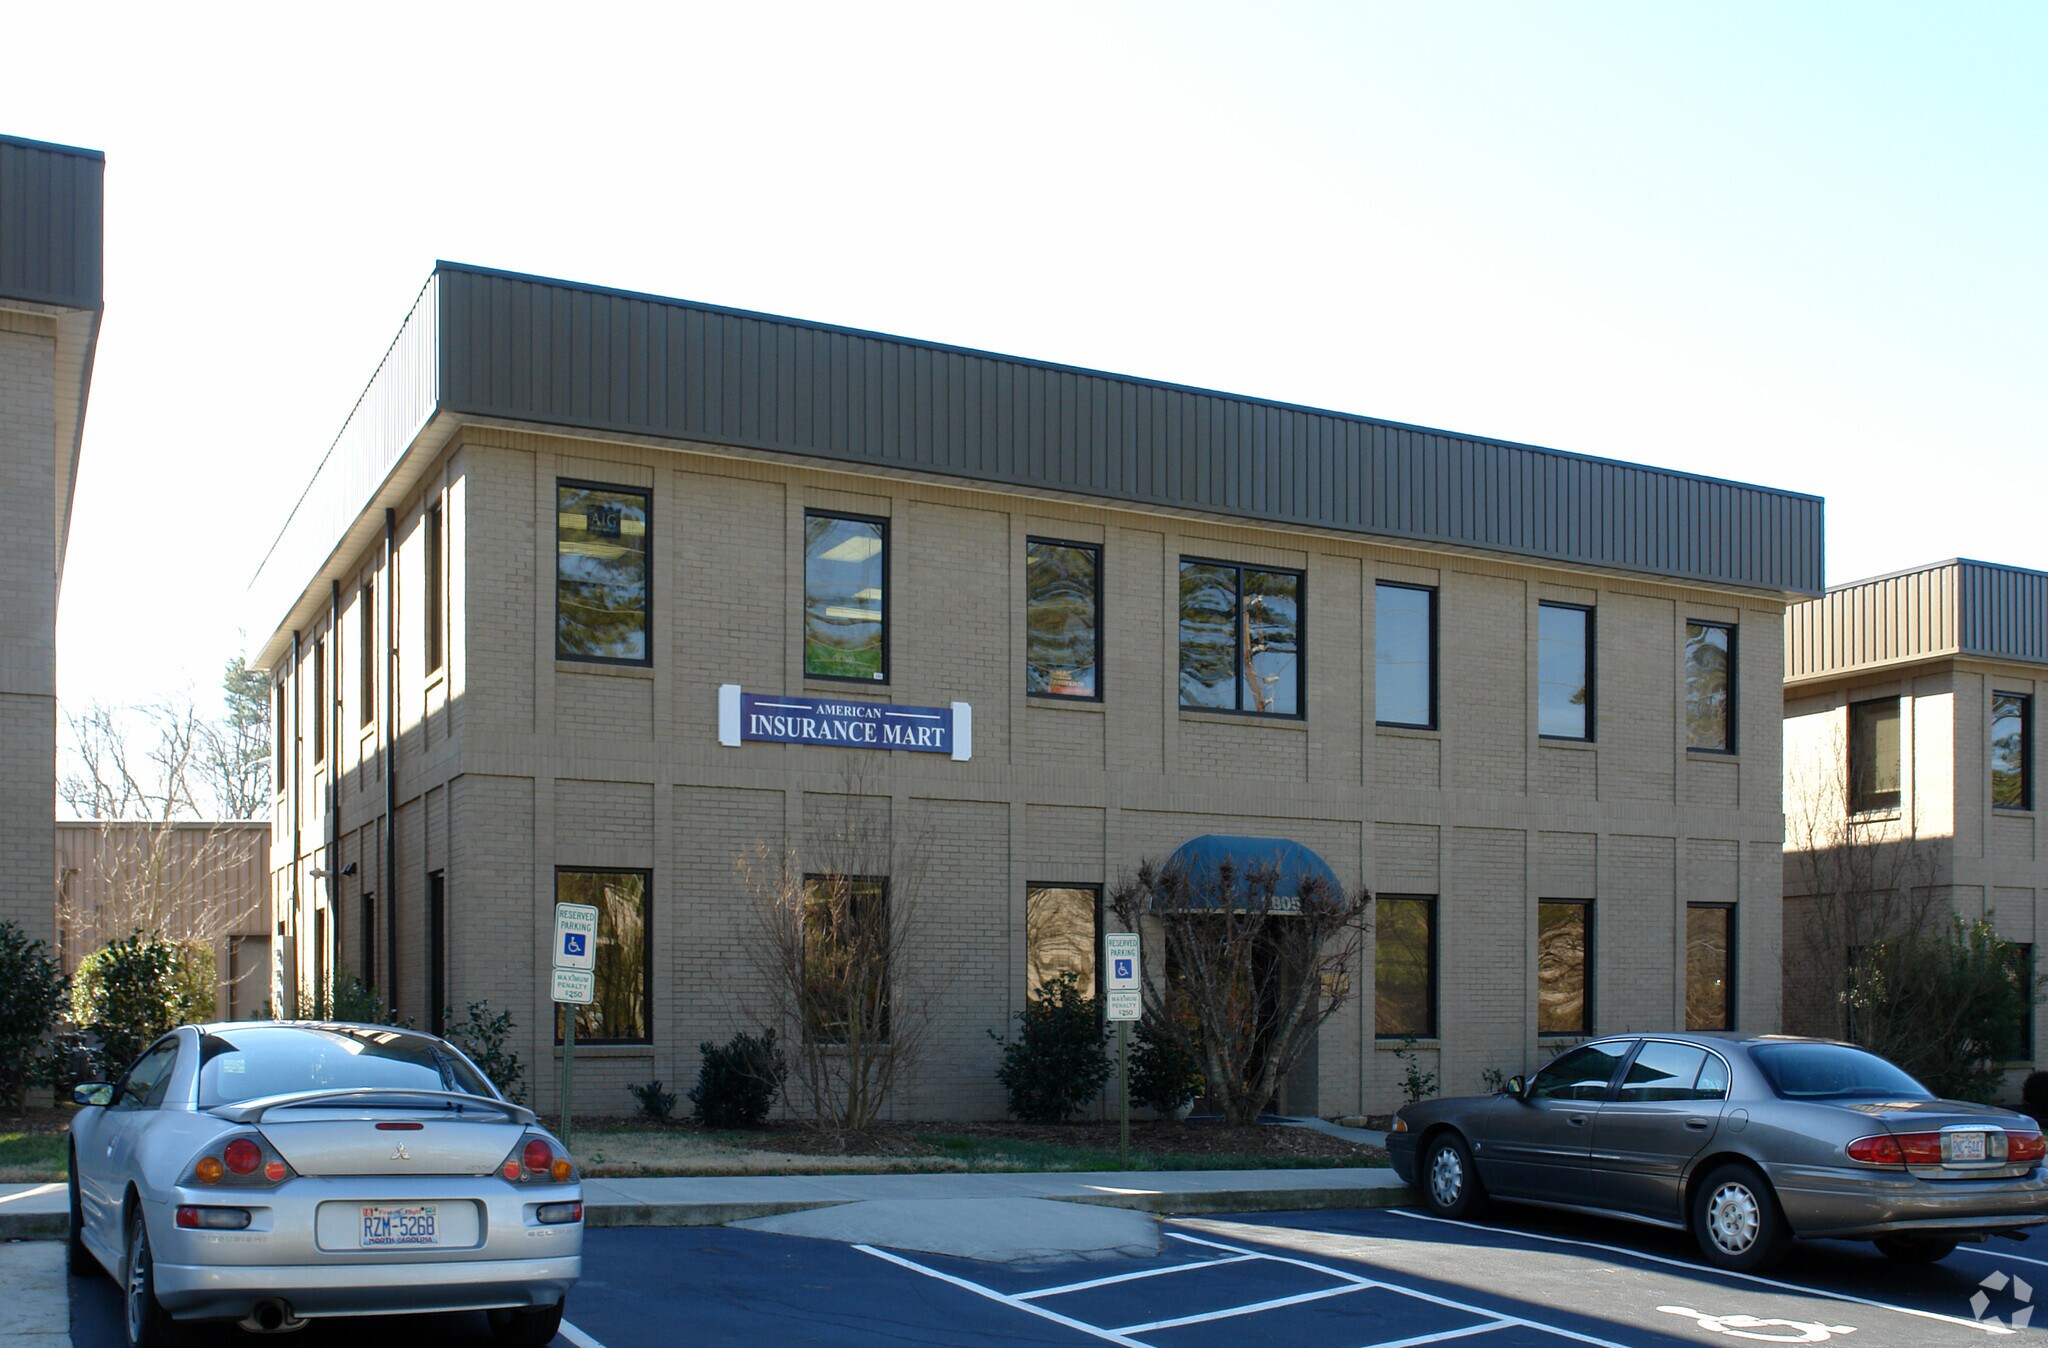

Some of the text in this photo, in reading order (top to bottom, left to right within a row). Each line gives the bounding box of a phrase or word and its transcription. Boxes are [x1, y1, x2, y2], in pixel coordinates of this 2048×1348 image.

[592, 512, 617, 528] AIG
[815, 704, 882, 719] AMERICAN
[749, 714, 945, 747] INSURANCE MART
[559, 909, 595, 921] RESERVED
[560, 920, 592, 932] PARKING
[1108, 939, 1138, 947] RESERVED
[1110, 949, 1136, 957] PARKING
[557, 974, 589, 983] MAXIMUM
[557, 981, 588, 991] PENALTY
[565, 990, 583, 999] $250
[364, 1216, 435, 1237] RZM-5268
[368, 1236, 433, 1245] NORTH CAROLINA
